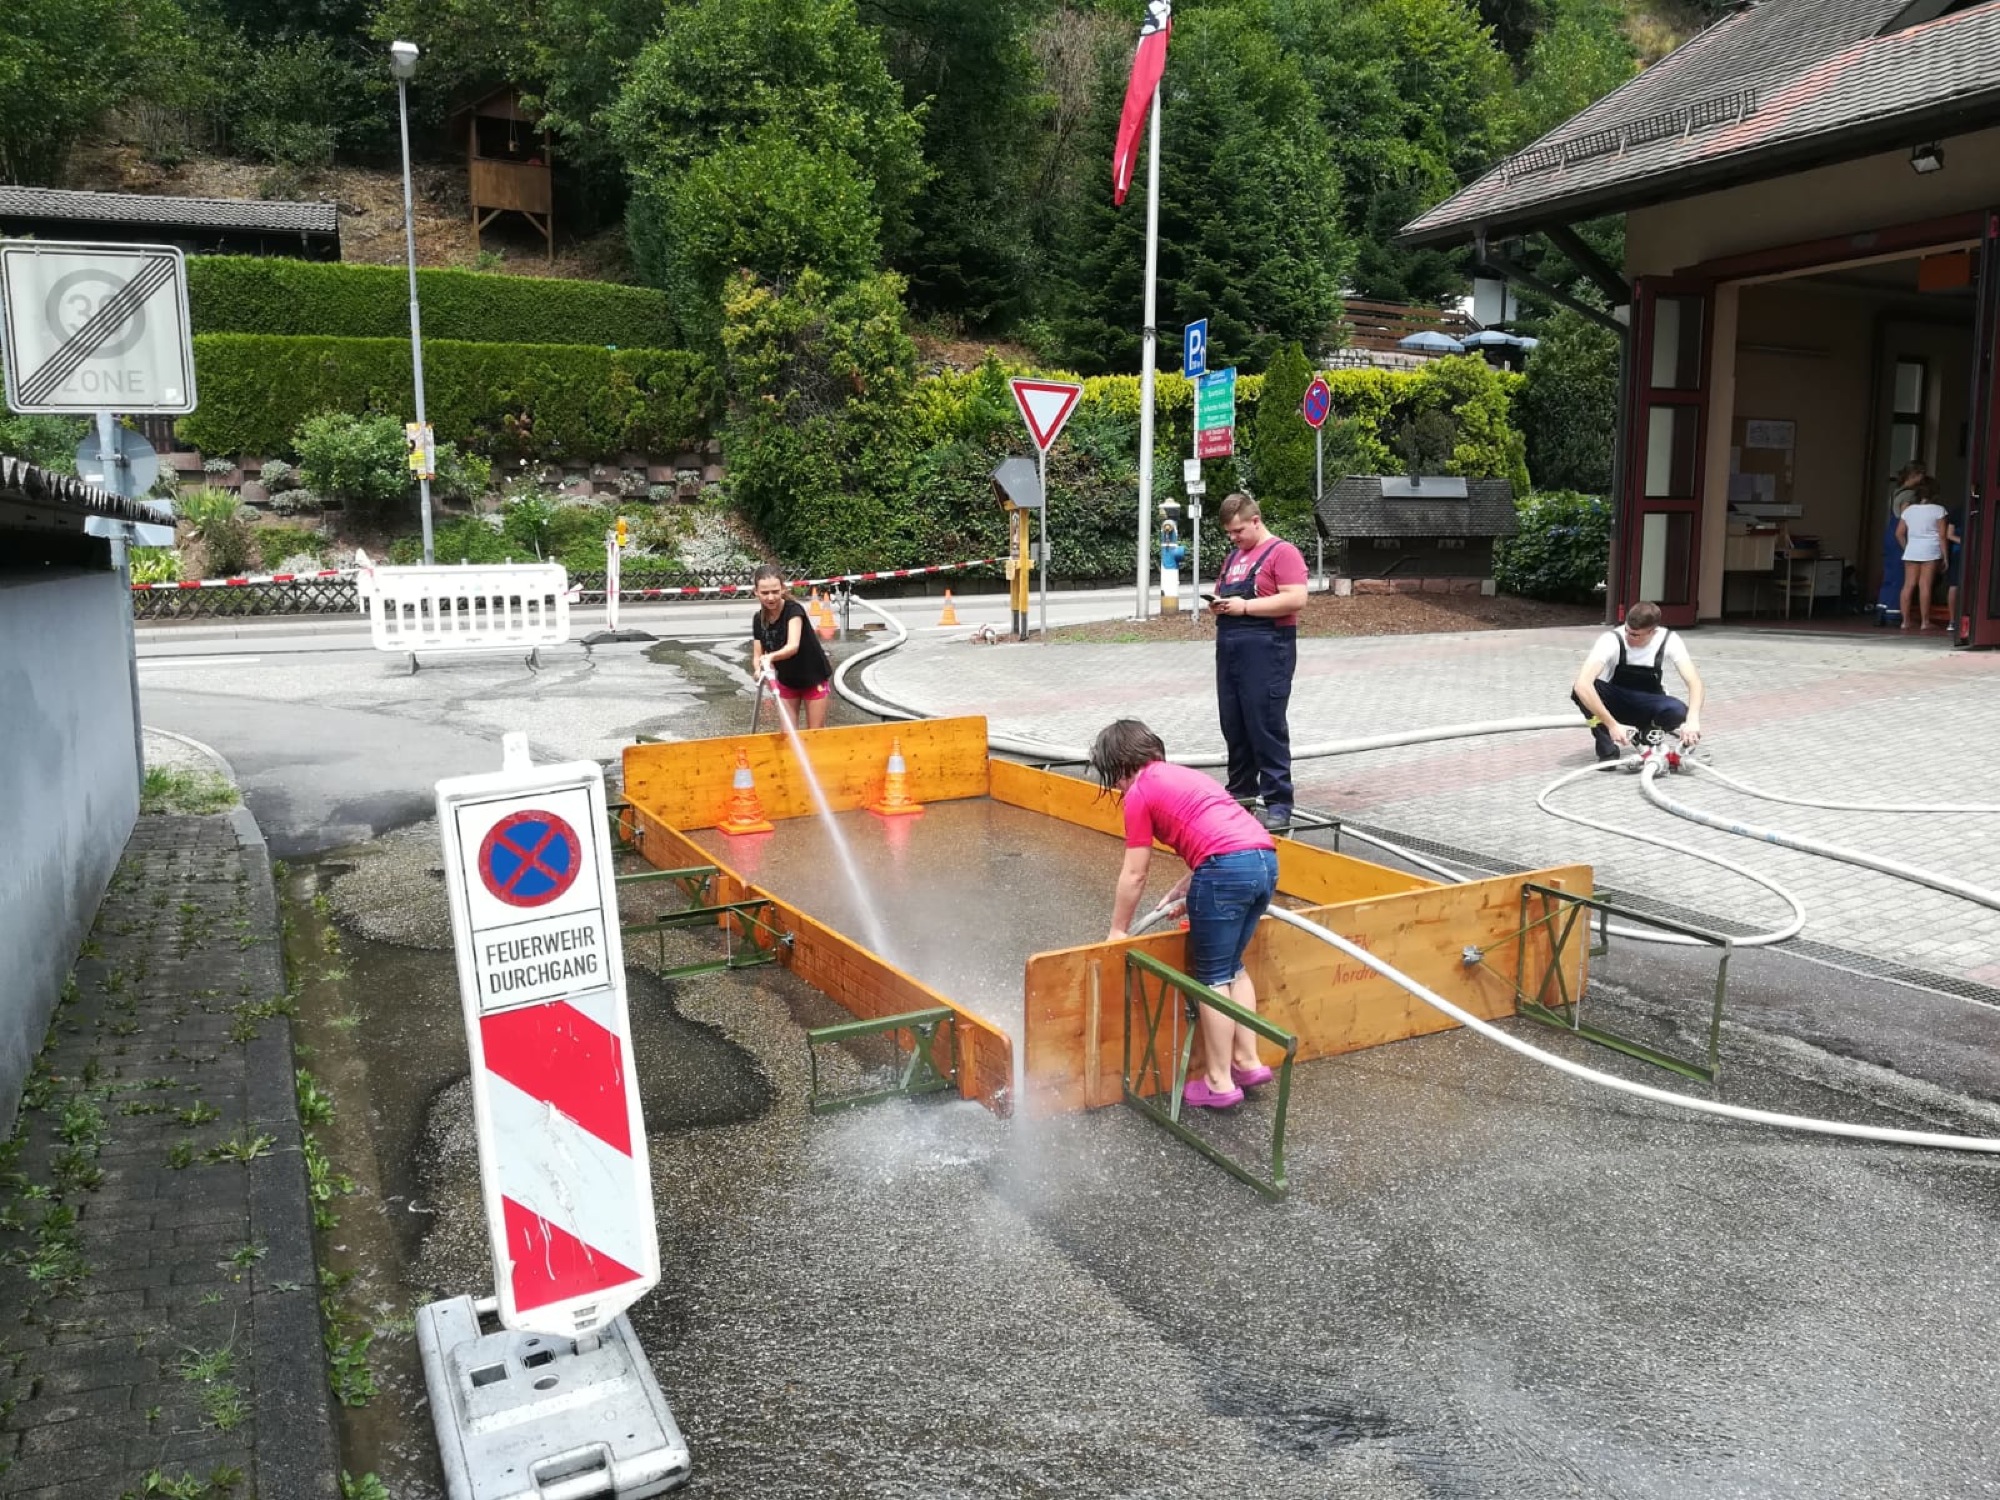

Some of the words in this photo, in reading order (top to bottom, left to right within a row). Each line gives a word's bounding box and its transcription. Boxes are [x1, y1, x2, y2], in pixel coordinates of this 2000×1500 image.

[1189, 329, 1201, 370] P
[61, 369, 146, 393] ZONE
[486, 926, 596, 966] FEUERWEHR
[490, 954, 598, 994] DURCHGANG
